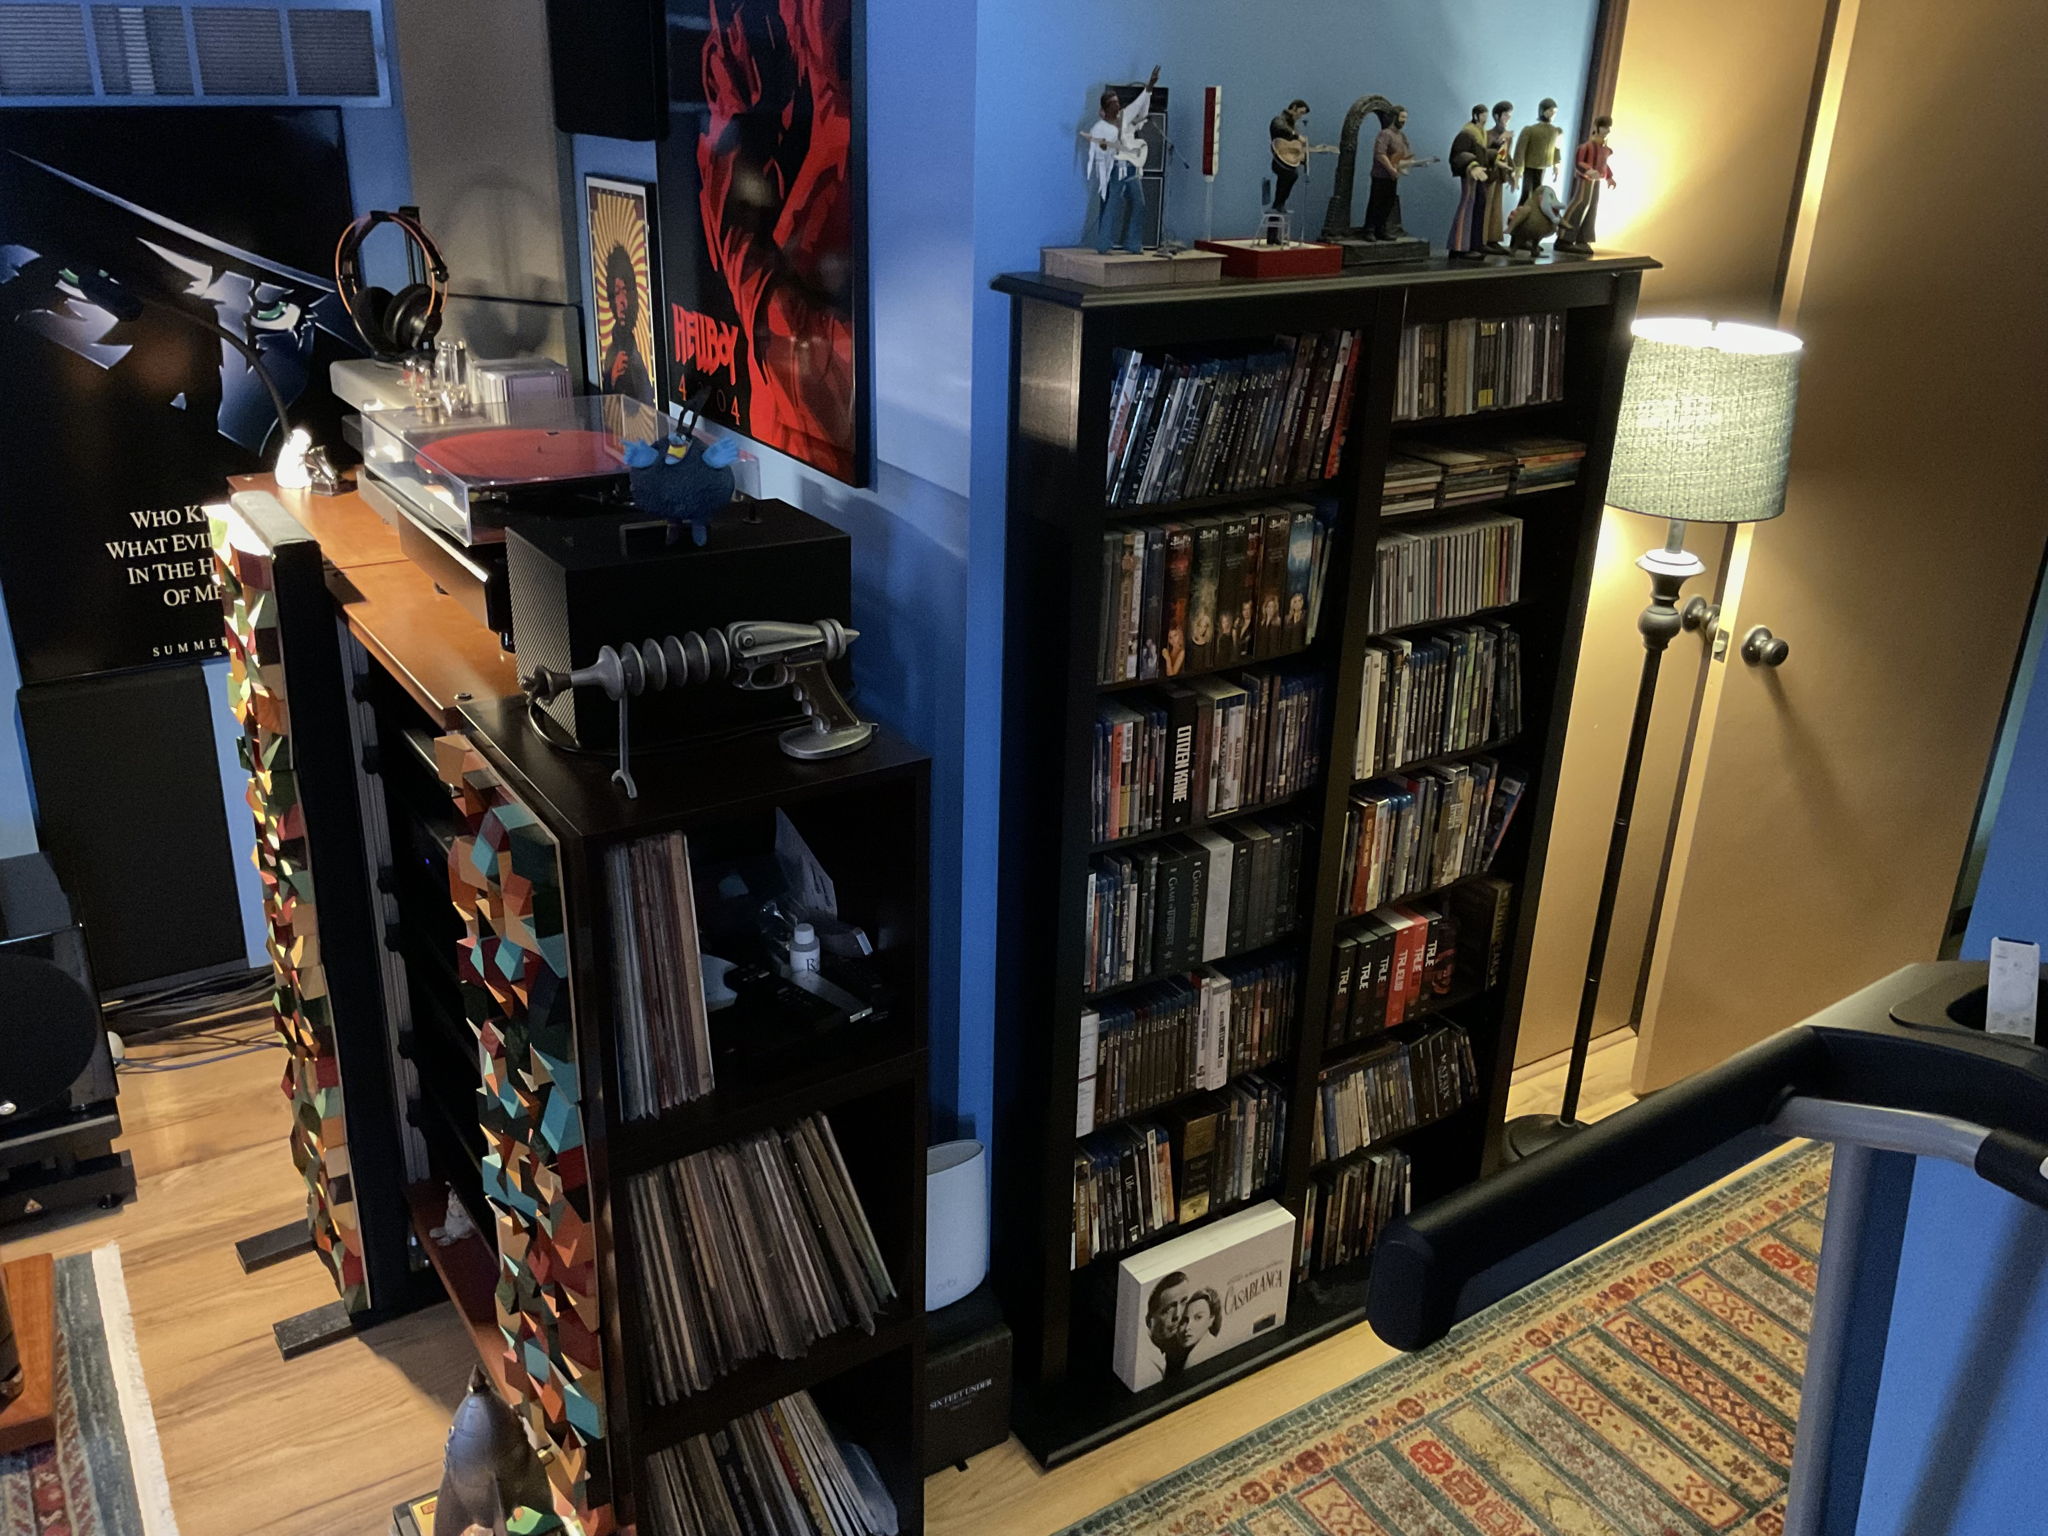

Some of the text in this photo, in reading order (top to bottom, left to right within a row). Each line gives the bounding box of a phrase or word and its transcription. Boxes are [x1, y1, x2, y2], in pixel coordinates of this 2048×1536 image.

[671, 302, 738, 386] HELLBOY
[1137, 430, 1157, 477] AVATAR
[130, 504, 208, 529] WHO K
[105, 540, 168, 560] WHAT
[127, 567, 150, 585] IN
[152, 562, 196, 581] THE
[163, 588, 191, 607] OF
[1172, 724, 1192, 804] CITIZEN KANE
[1337, 966, 1350, 996] TRUE
[1359, 961, 1372, 991] TRUE
[1224, 1269, 1283, 1316] CASABLANCA
